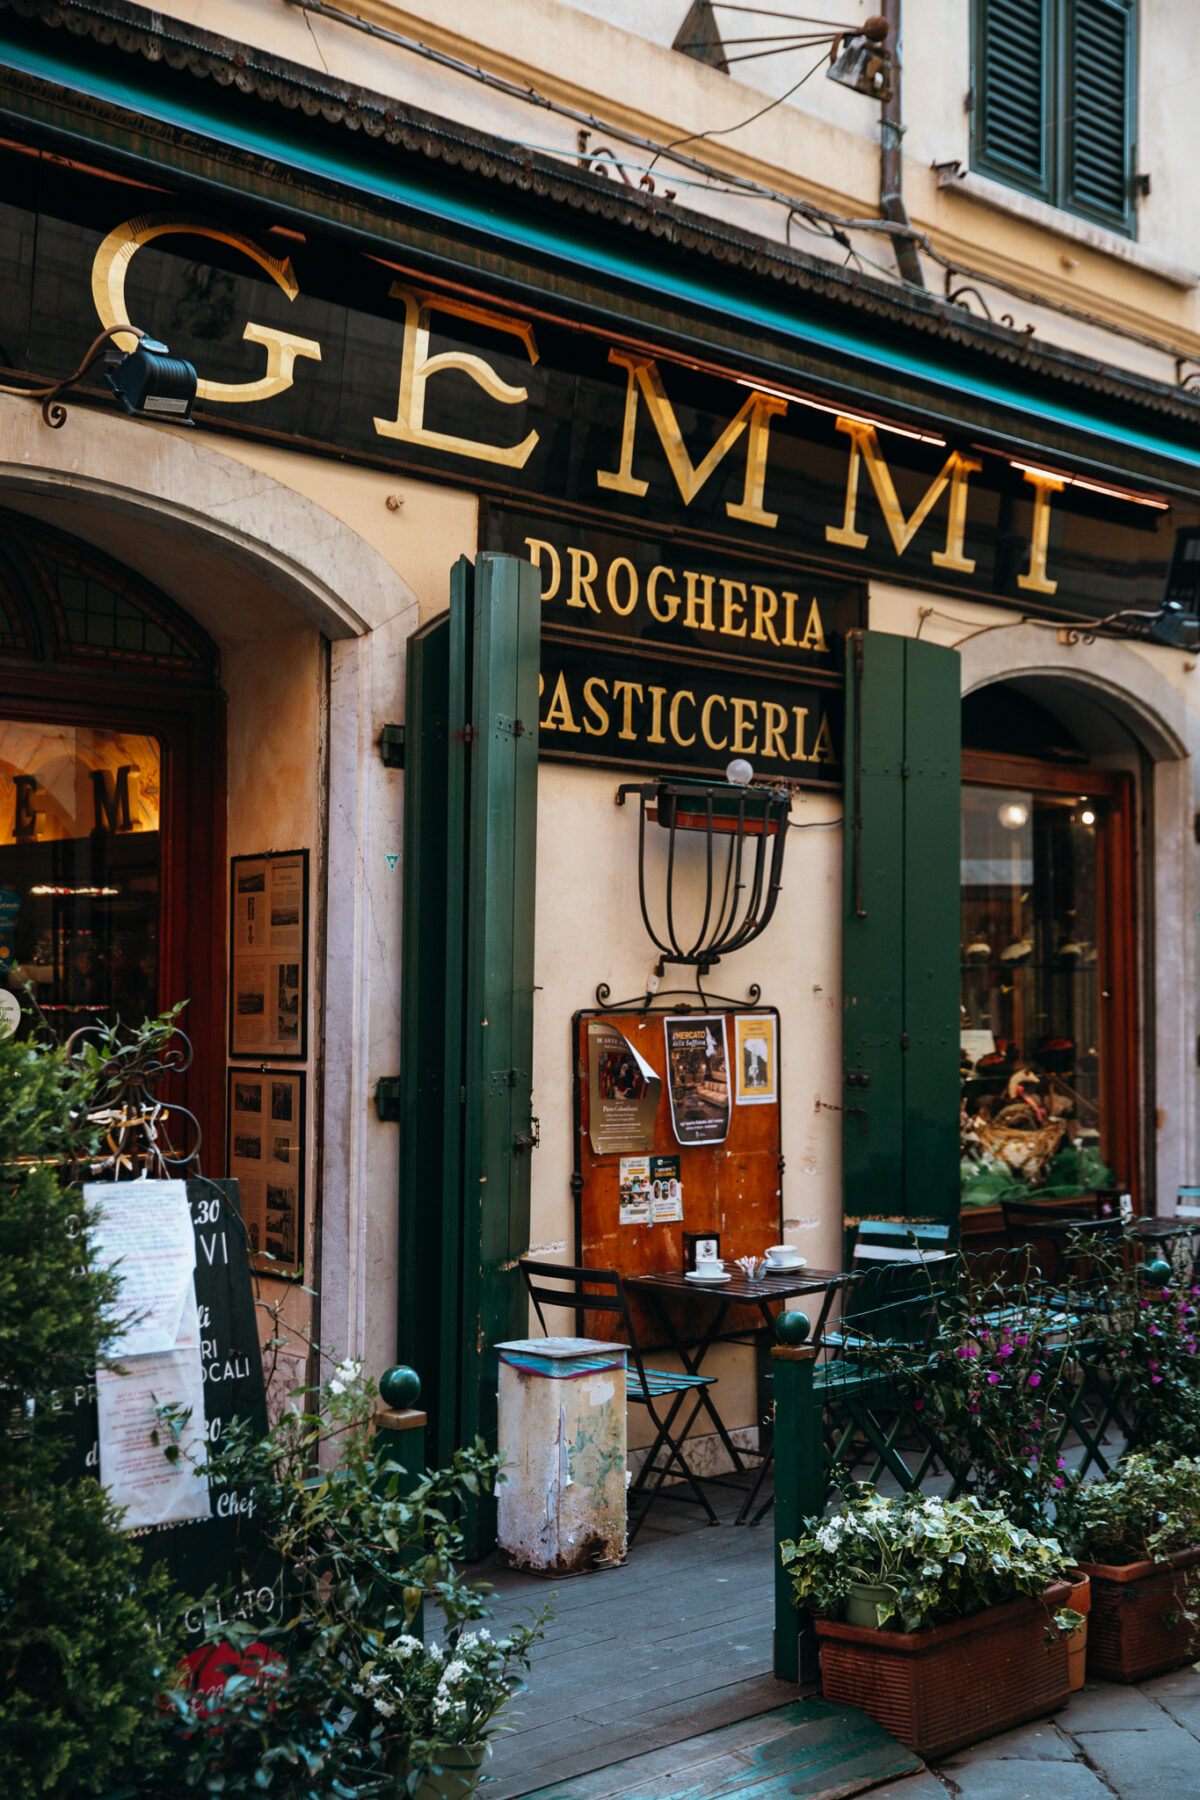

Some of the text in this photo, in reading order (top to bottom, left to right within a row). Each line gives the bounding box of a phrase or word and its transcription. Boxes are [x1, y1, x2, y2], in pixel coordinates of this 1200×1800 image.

[90, 212, 1065, 594] GEMMI
[524, 537, 831, 652] DROGHERIA
[539, 669, 837, 764] ASTICCERIA
